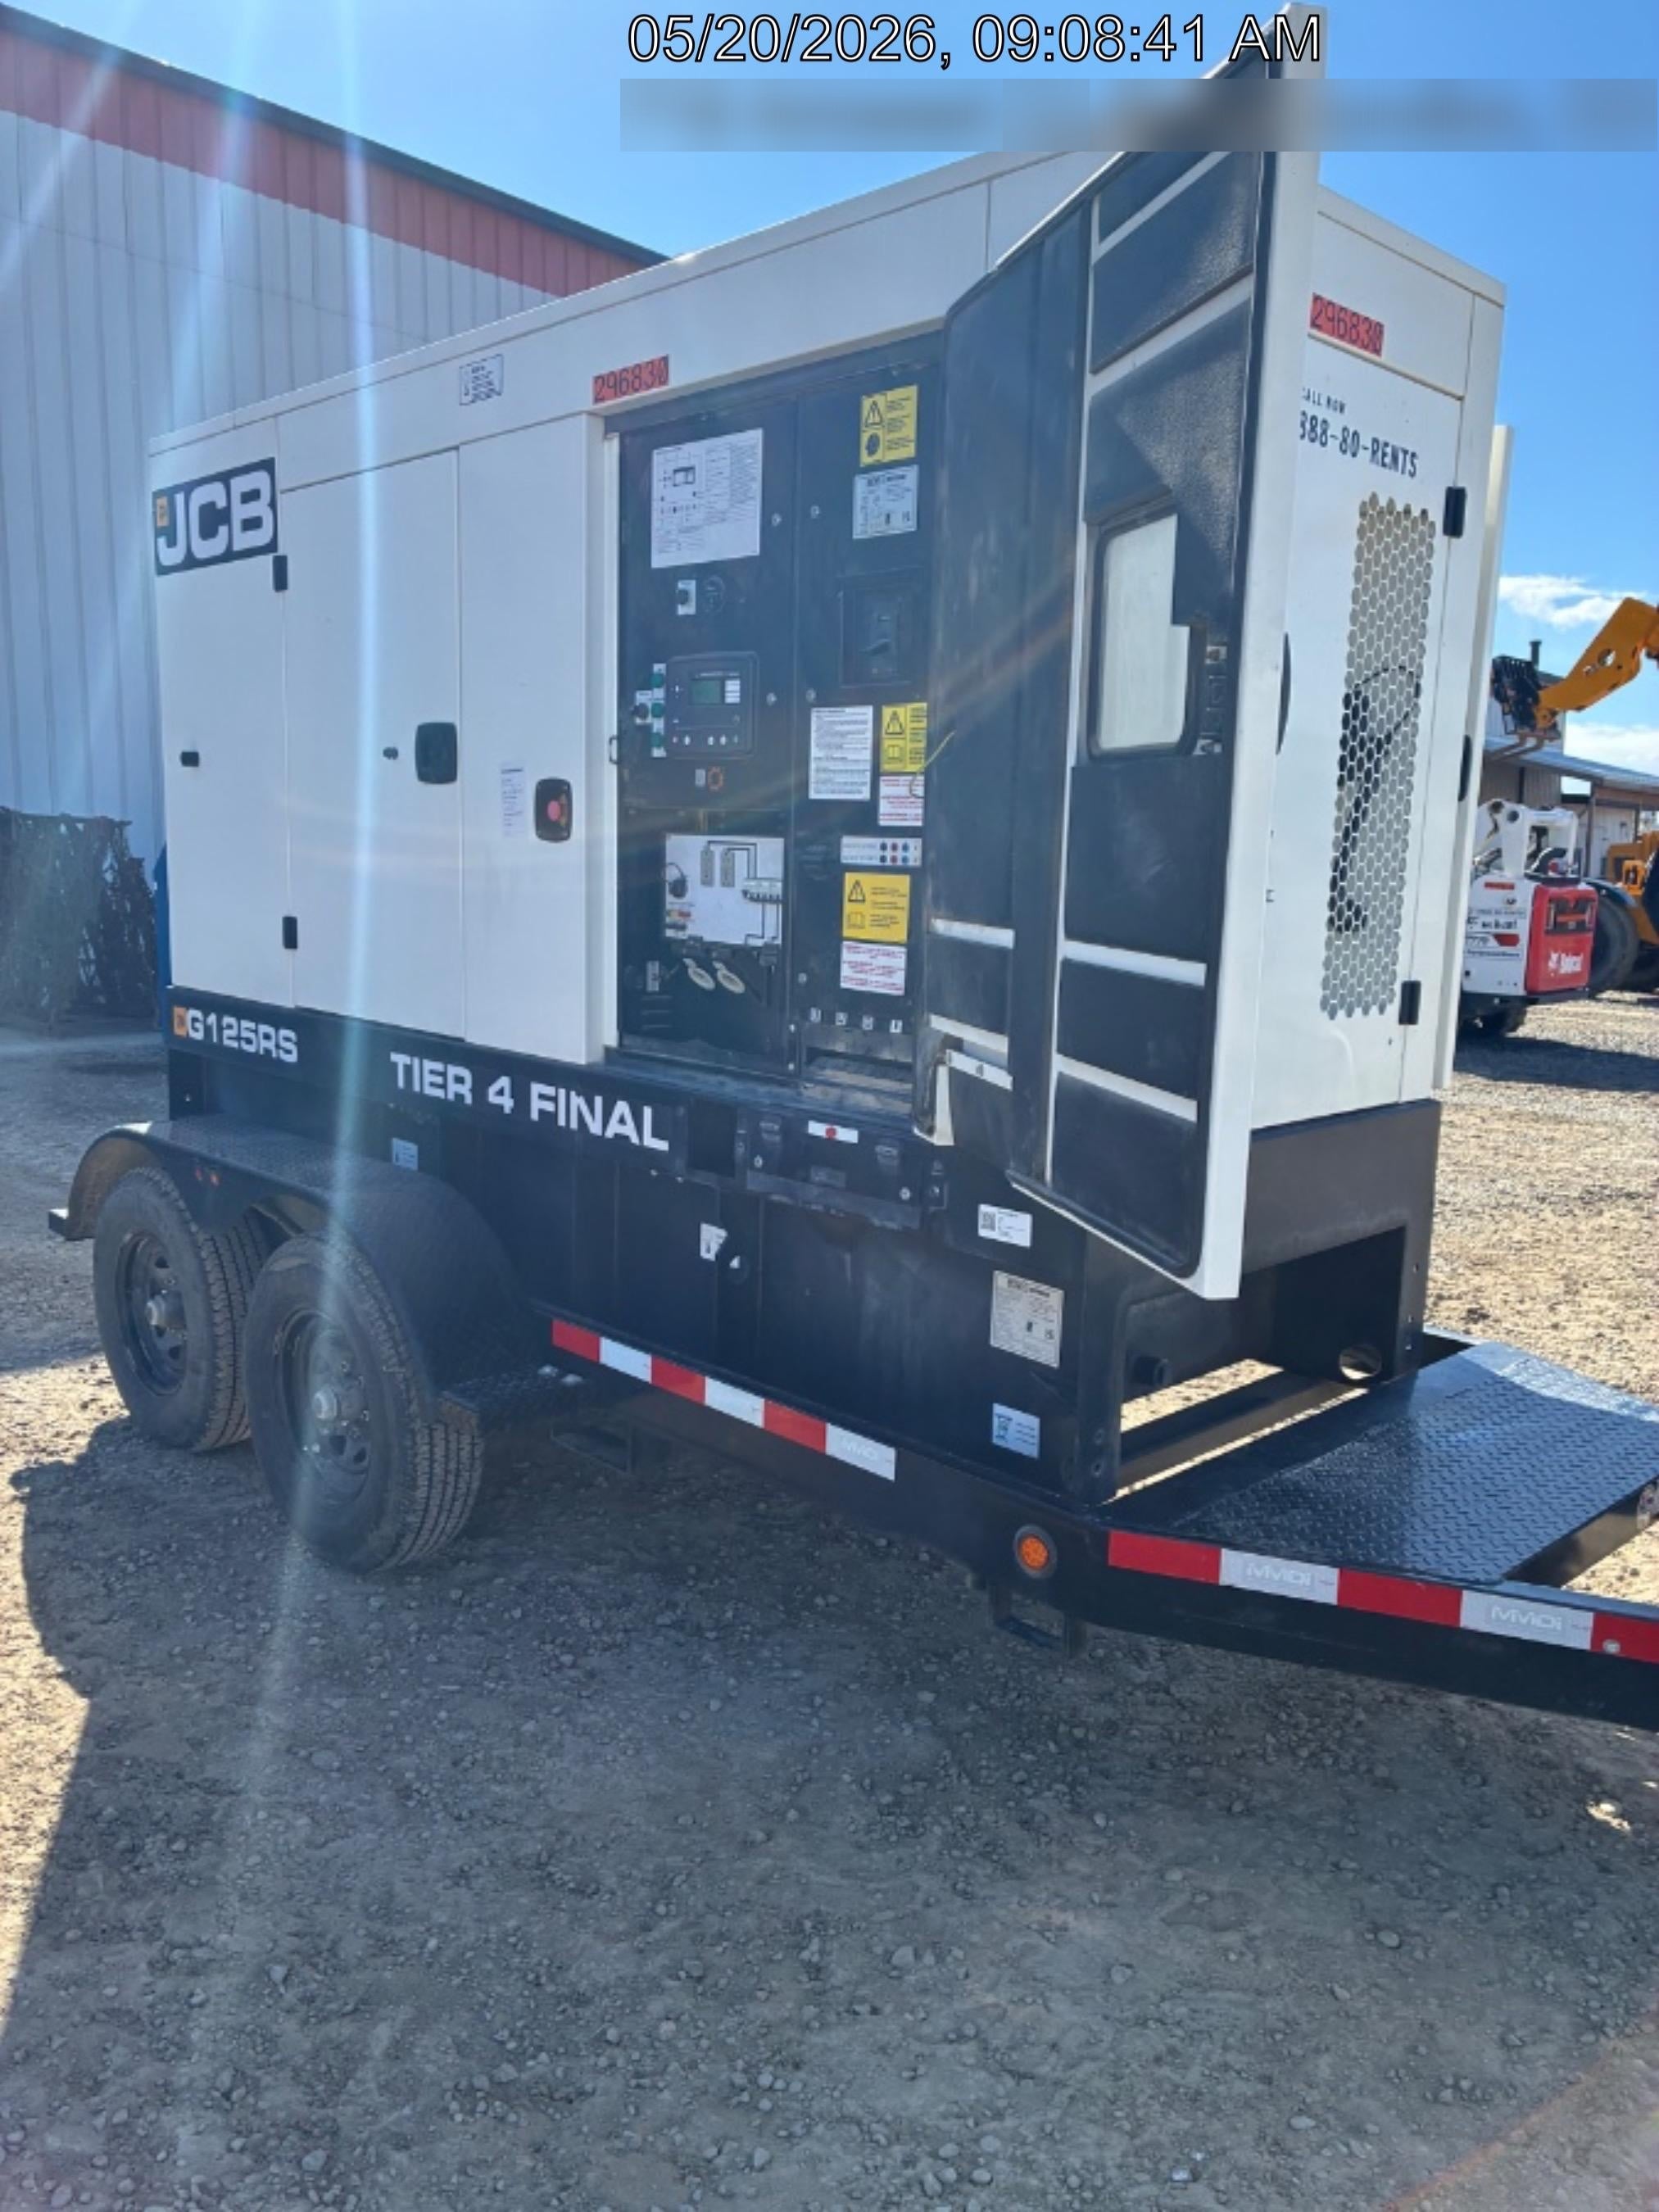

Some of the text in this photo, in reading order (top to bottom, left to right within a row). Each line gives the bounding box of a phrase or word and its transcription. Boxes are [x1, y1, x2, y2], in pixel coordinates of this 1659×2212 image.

[1311, 294, 1385, 356] 296830
[594, 356, 669, 404] 296830
[1327, 396, 1345, 414] NOW
[156, 469, 275, 567] JCB
[186, 1008, 298, 1063] G125RS
[390, 1052, 669, 1152] TIER 4 FINAL
